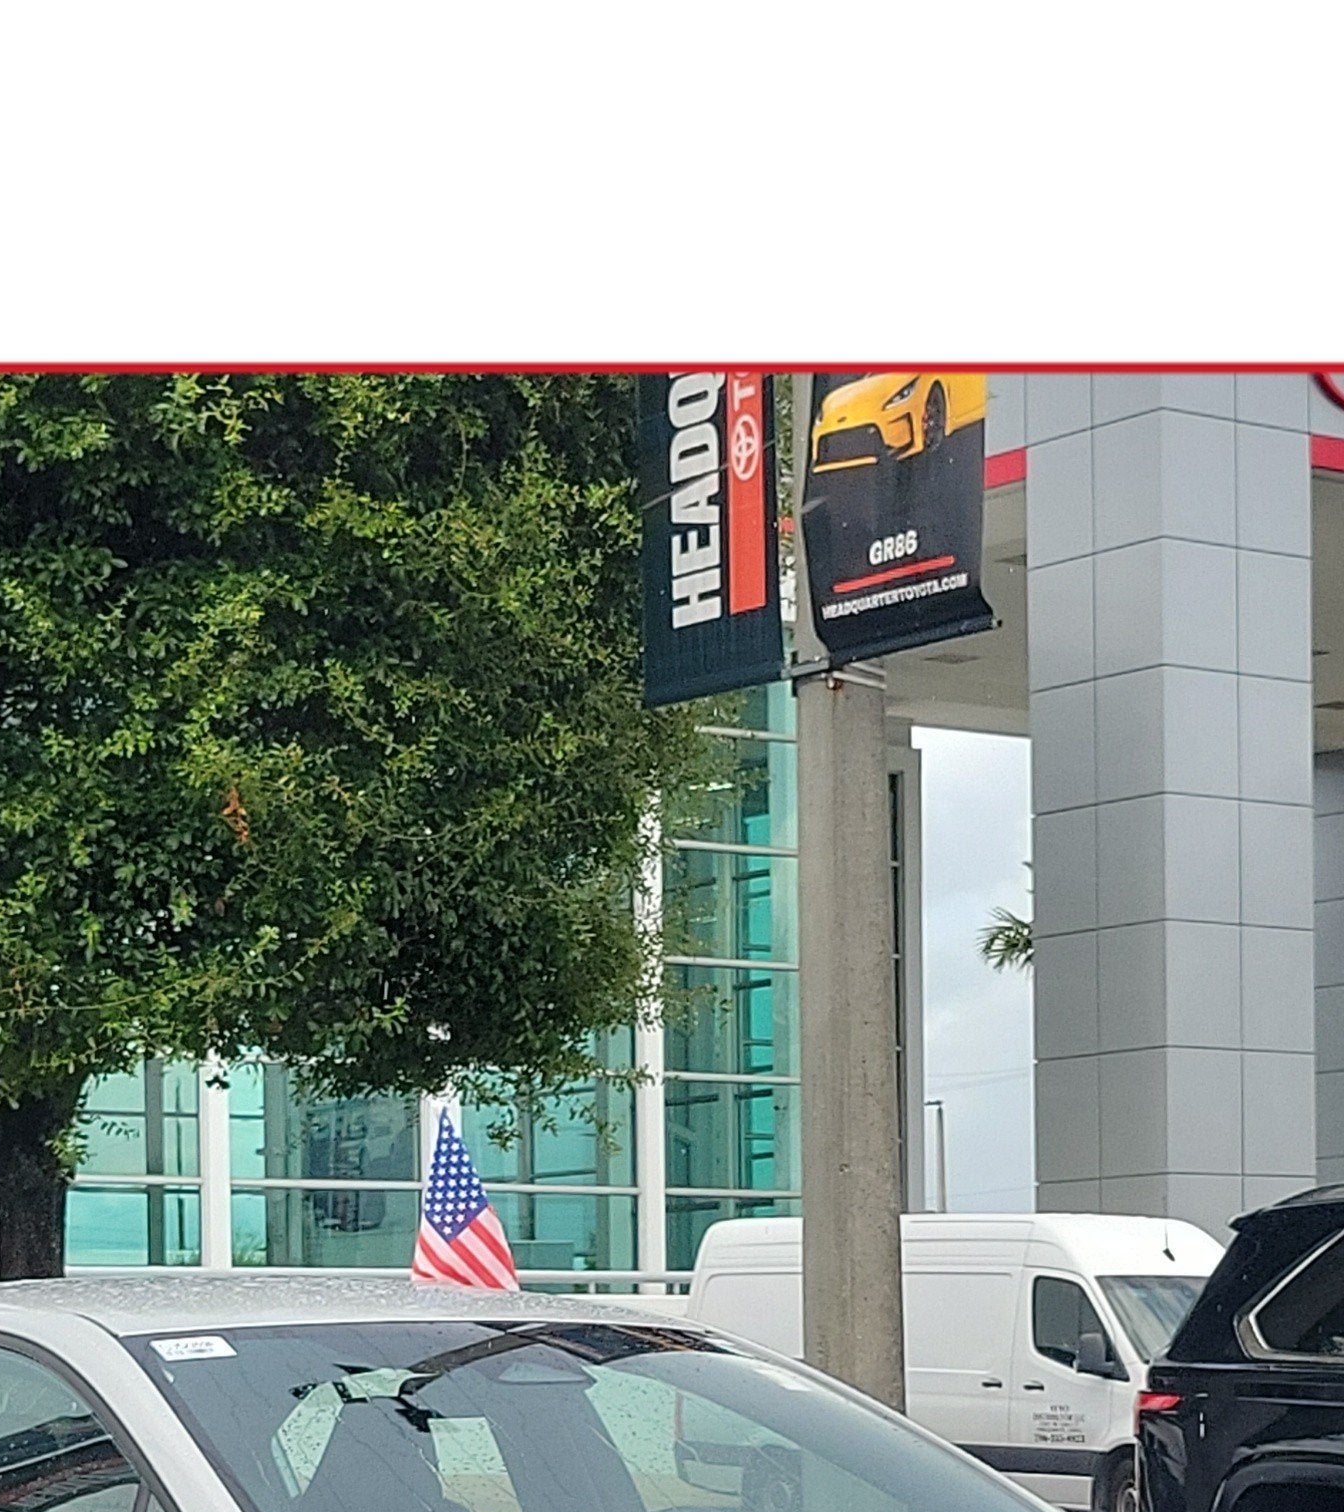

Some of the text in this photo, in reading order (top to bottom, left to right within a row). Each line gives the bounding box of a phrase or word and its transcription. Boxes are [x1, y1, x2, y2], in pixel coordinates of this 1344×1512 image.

[668, 372, 726, 629] HEADQ
[869, 529, 919, 566] GR86
[821, 572, 969, 621] HEADQUARTERTOYOTA.COM
